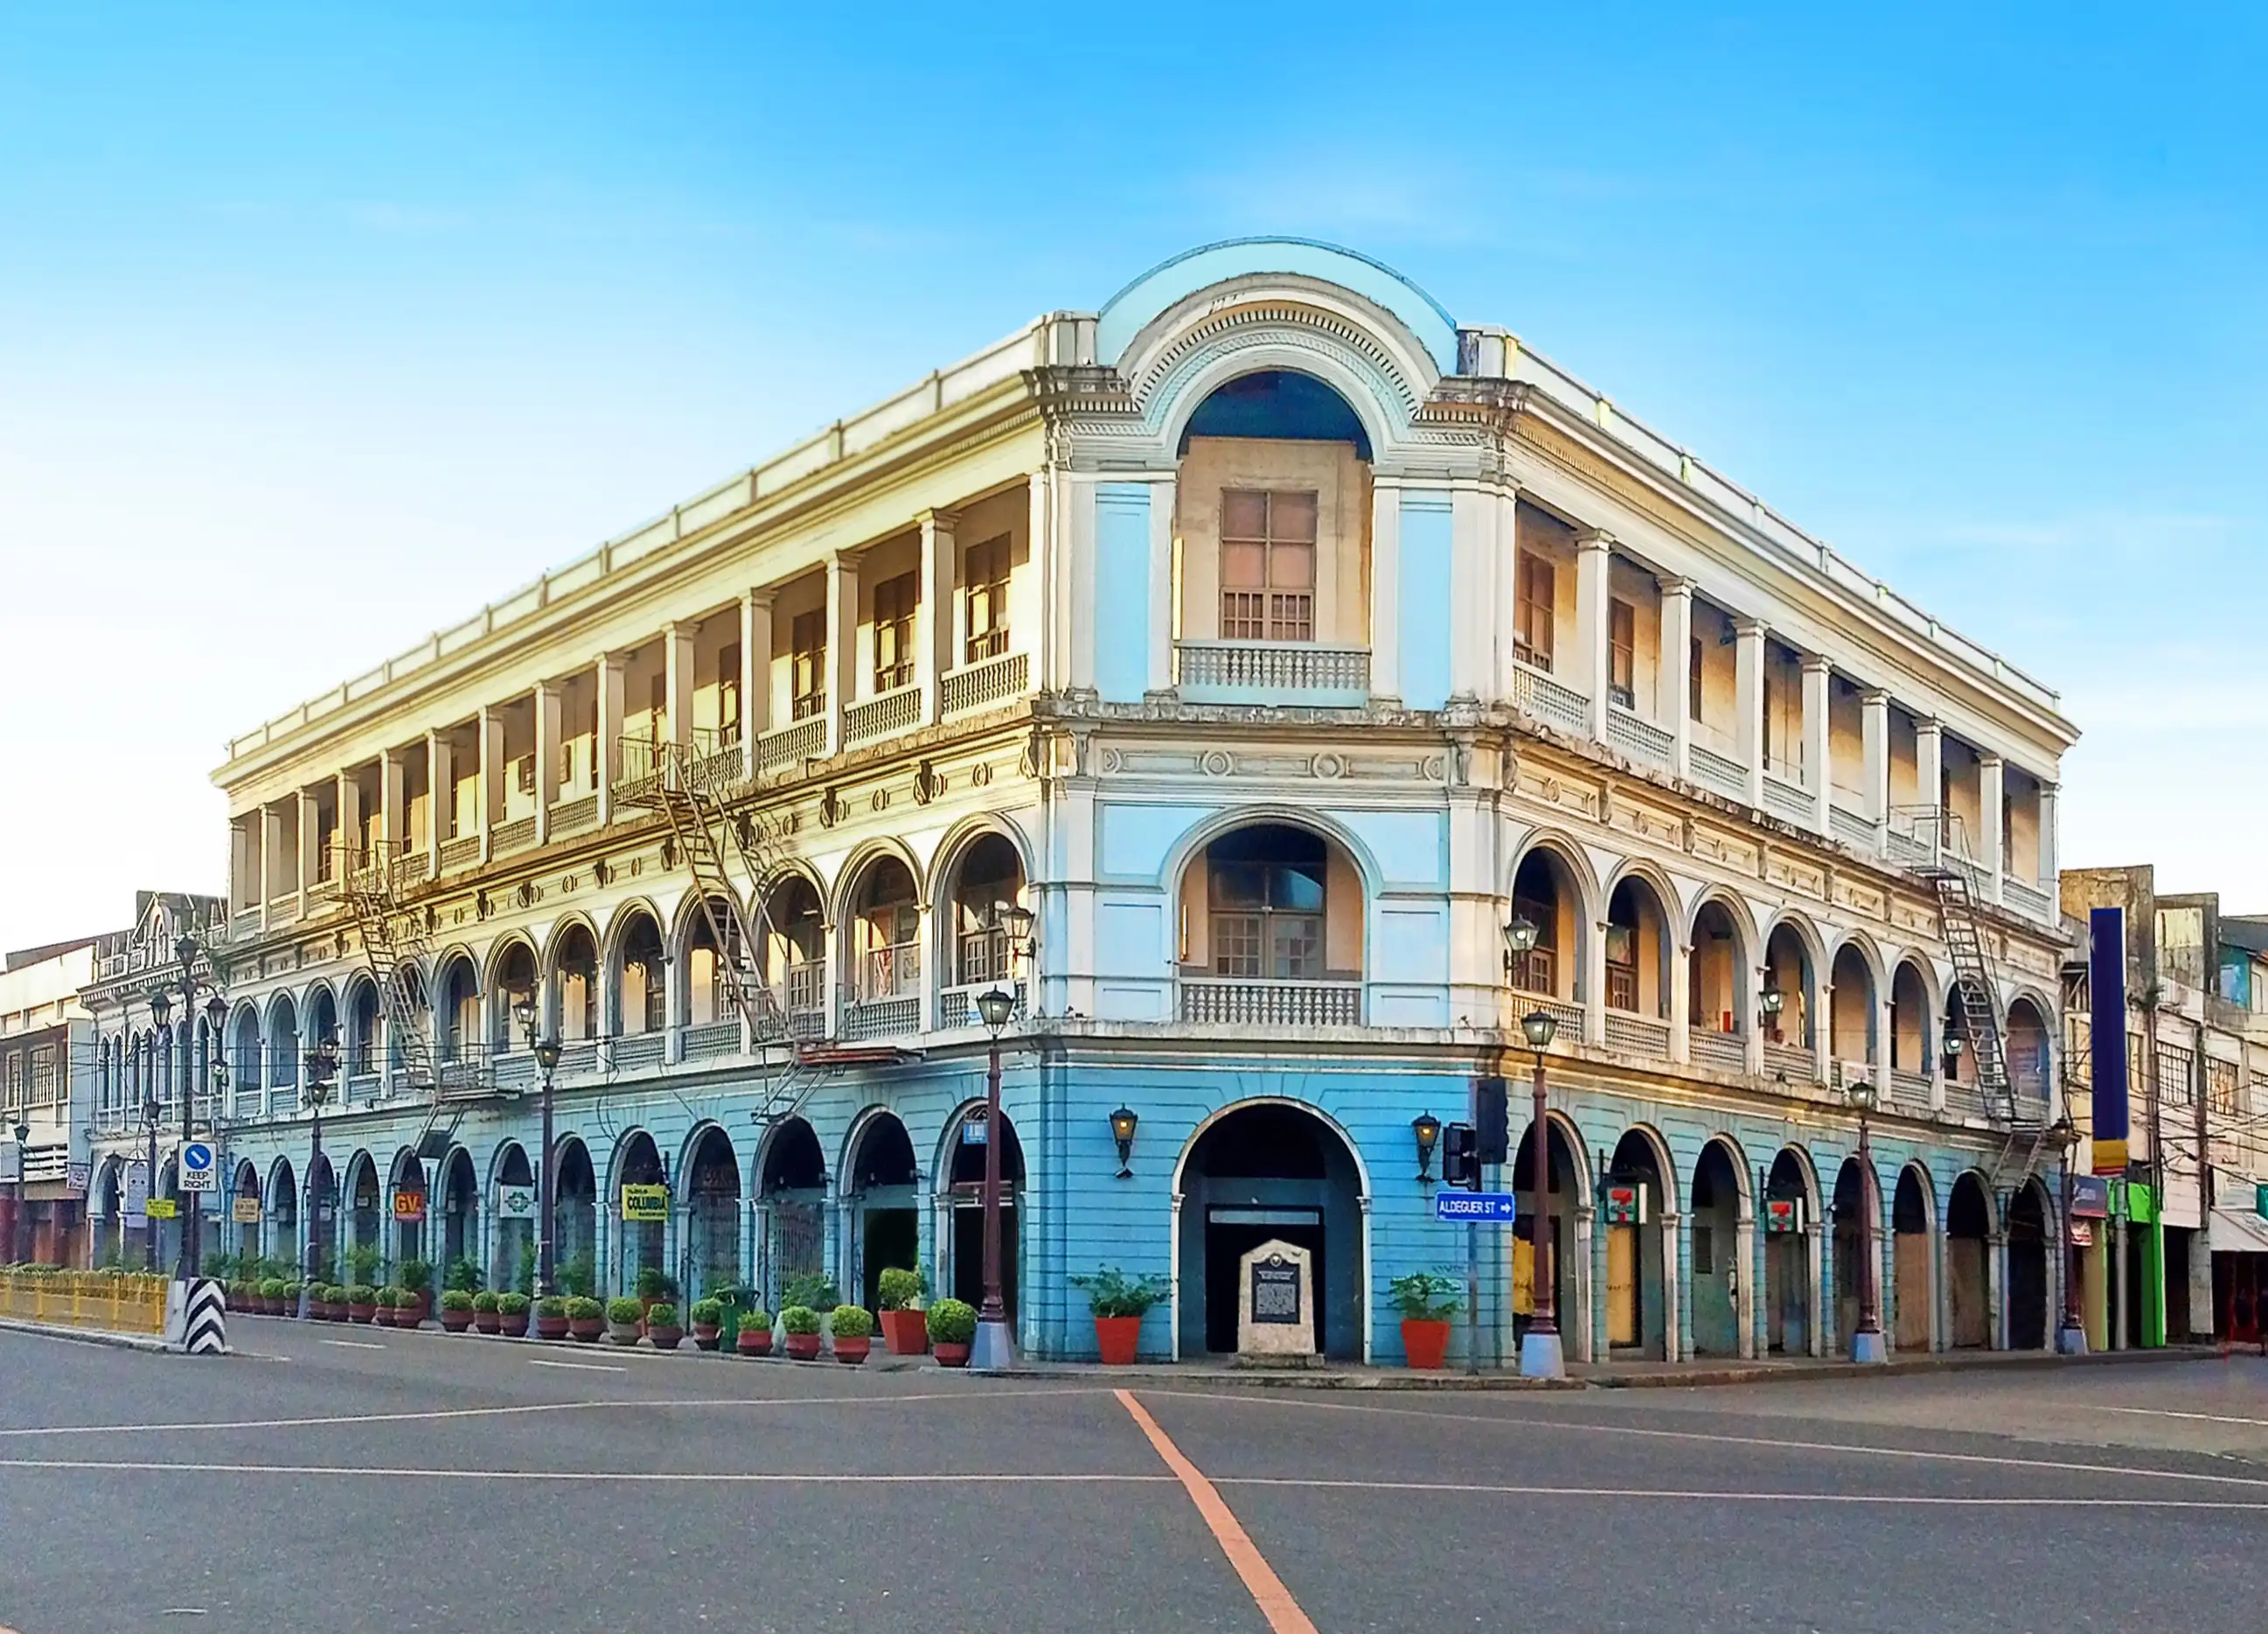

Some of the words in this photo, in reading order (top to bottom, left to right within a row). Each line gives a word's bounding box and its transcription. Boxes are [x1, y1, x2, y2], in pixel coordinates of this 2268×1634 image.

[184, 1180, 211, 1189] RIGHT
[1439, 1200, 1484, 1213] ALDEGUER
[1485, 1201, 1495, 1213] ST
